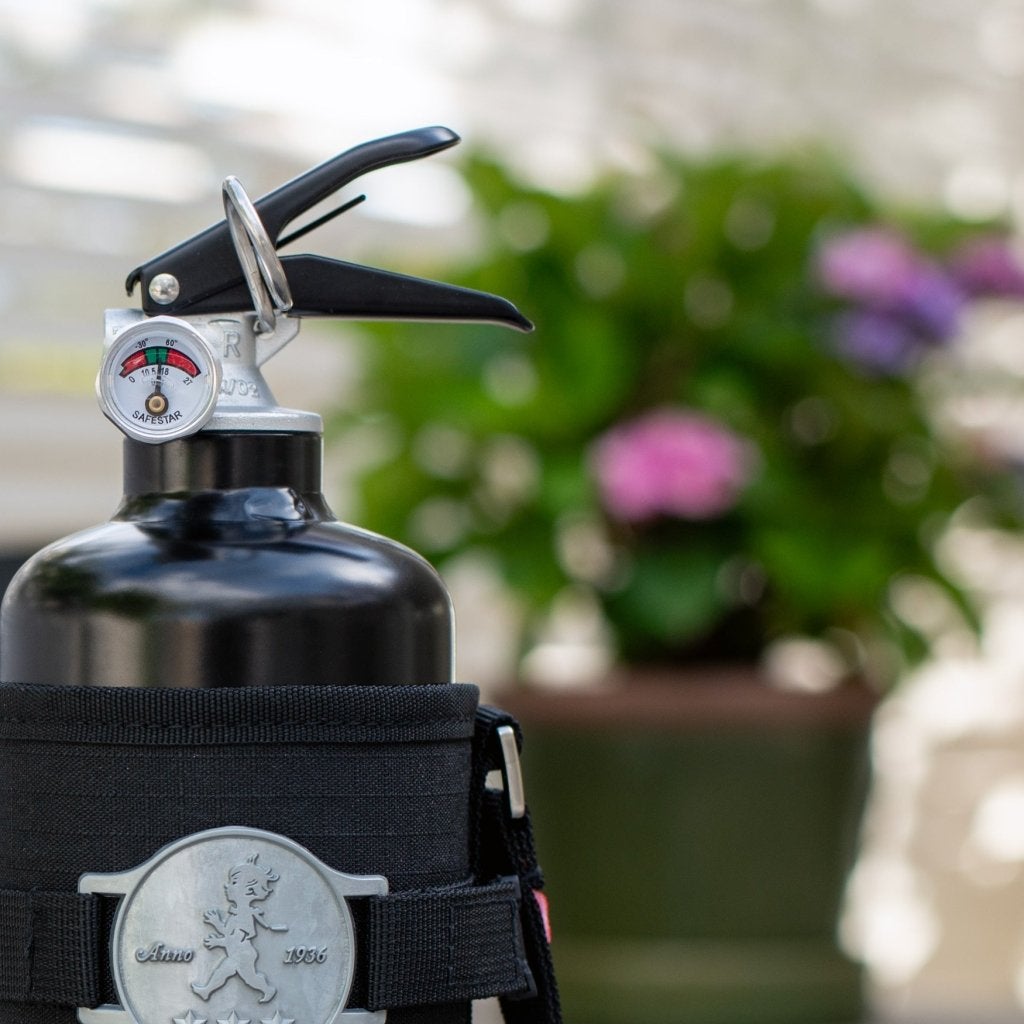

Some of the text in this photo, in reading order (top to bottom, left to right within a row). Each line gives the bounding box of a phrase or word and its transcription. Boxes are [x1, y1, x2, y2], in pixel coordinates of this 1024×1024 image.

[223, 330, 241, 358] R
[132, 410, 183, 424] SAFESTAR
[135, 942, 194, 963] Anno
[283, 945, 327, 964] 1936
